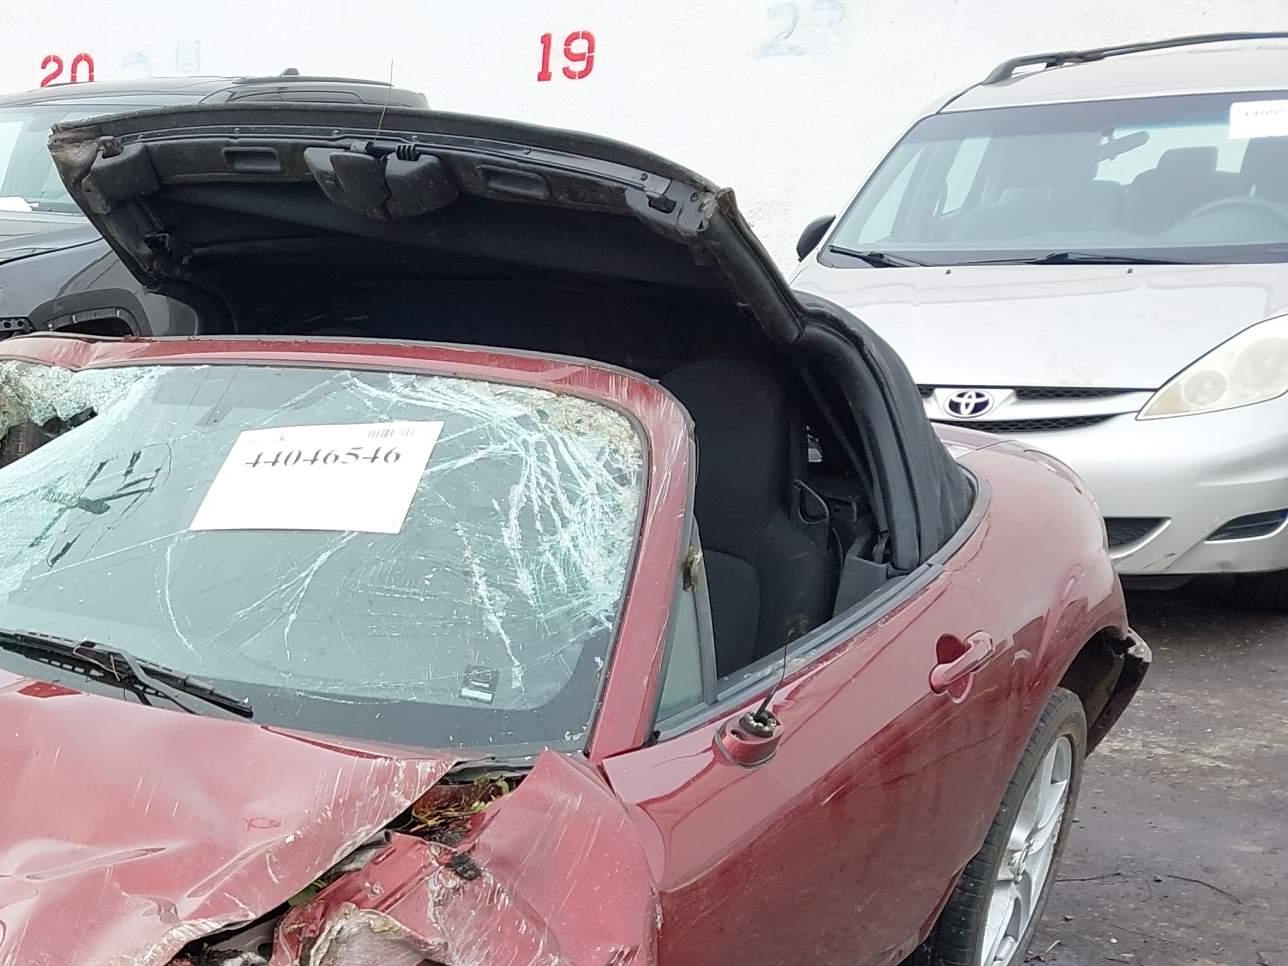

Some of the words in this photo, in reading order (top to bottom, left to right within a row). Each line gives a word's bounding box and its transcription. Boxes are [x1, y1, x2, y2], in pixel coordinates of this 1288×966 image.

[40, 53, 95, 88] 20
[537, 30, 596, 82] 19
[245, 446, 402, 468] 44046546
